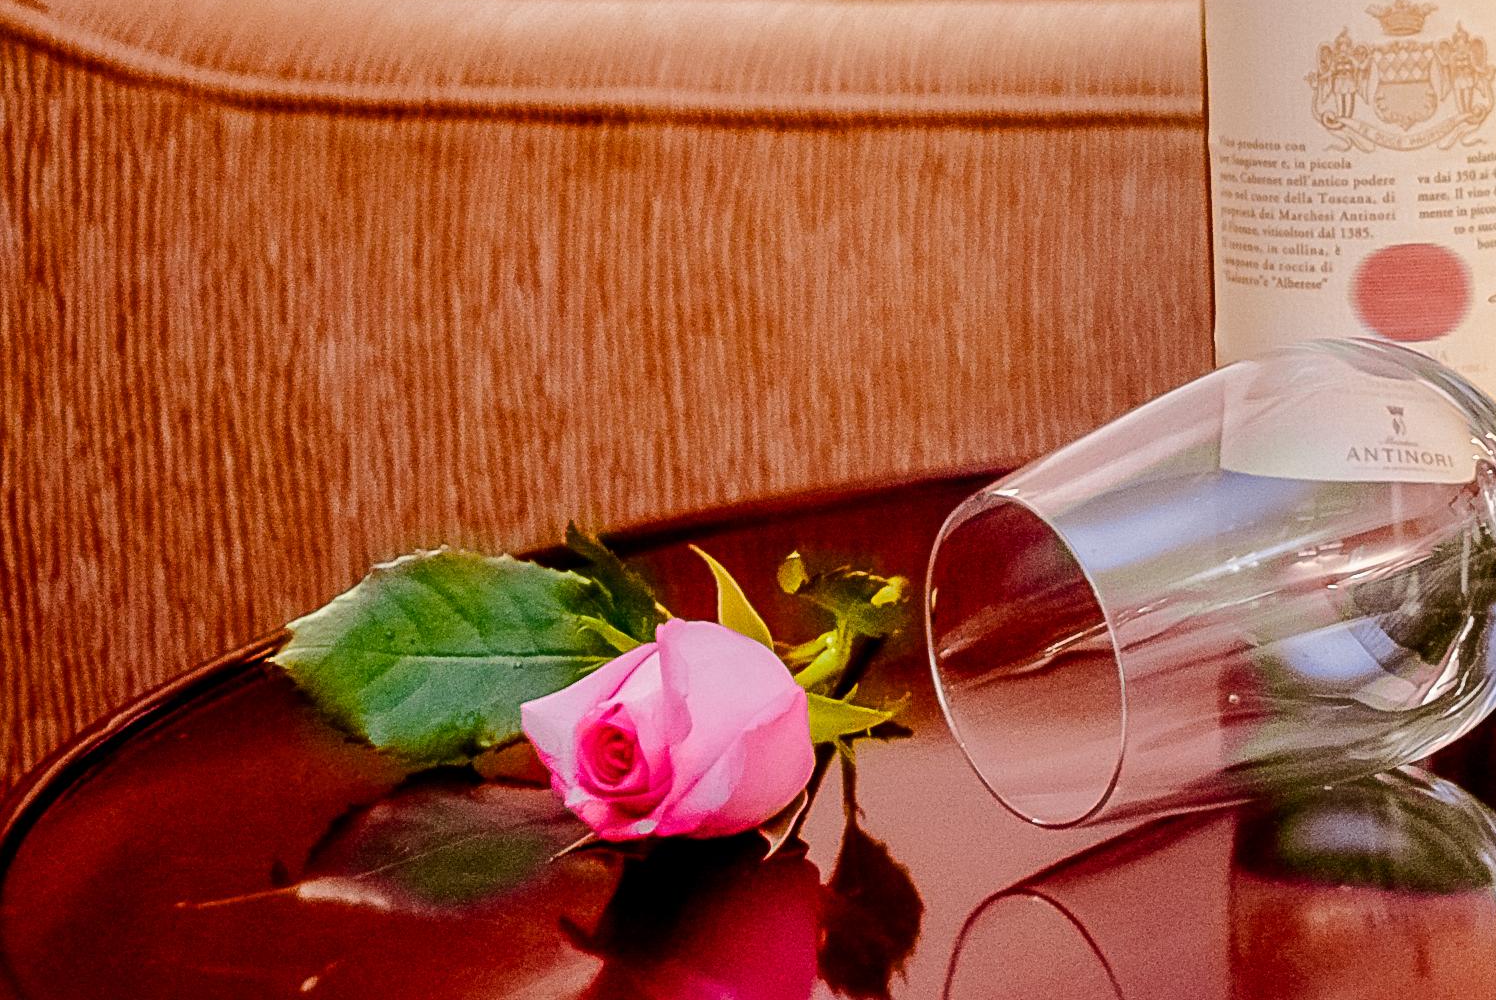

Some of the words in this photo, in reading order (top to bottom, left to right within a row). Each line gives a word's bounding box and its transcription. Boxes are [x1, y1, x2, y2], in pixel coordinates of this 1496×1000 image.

[1285, 142, 1306, 151] con
[1294, 158, 1305, 169] in
[1310, 158, 1352, 171] piccola
[1353, 174, 1396, 189] podere
[1417, 175, 1430, 185] va
[1434, 171, 1451, 184] dai
[1455, 170, 1476, 183] 350
[1480, 169, 1489, 180] ai
[1251, 193, 1282, 202] cuore
[1283, 191, 1313, 204] della
[1382, 191, 1396, 204] di
[1455, 187, 1463, 199] Il
[1467, 187, 1490, 199] vino
[1278, 209, 1334, 222] Marchesi
[1339, 209, 1396, 222] Antinori
[1419, 208, 1453, 219] mente
[1457, 206, 1467, 217] in
[1318, 227, 1335, 239] dal
[1341, 227, 1374, 239] 1385.
[1454, 224, 1465, 235] to
[1267, 242, 1278, 253] in
[1282, 243, 1329, 256] collina,
[1263, 259, 1274, 271] da
[1278, 261, 1315, 272] roccia
[1320, 261, 1333, 272] di
[1346, 447, 1454, 468] ANTINORI
